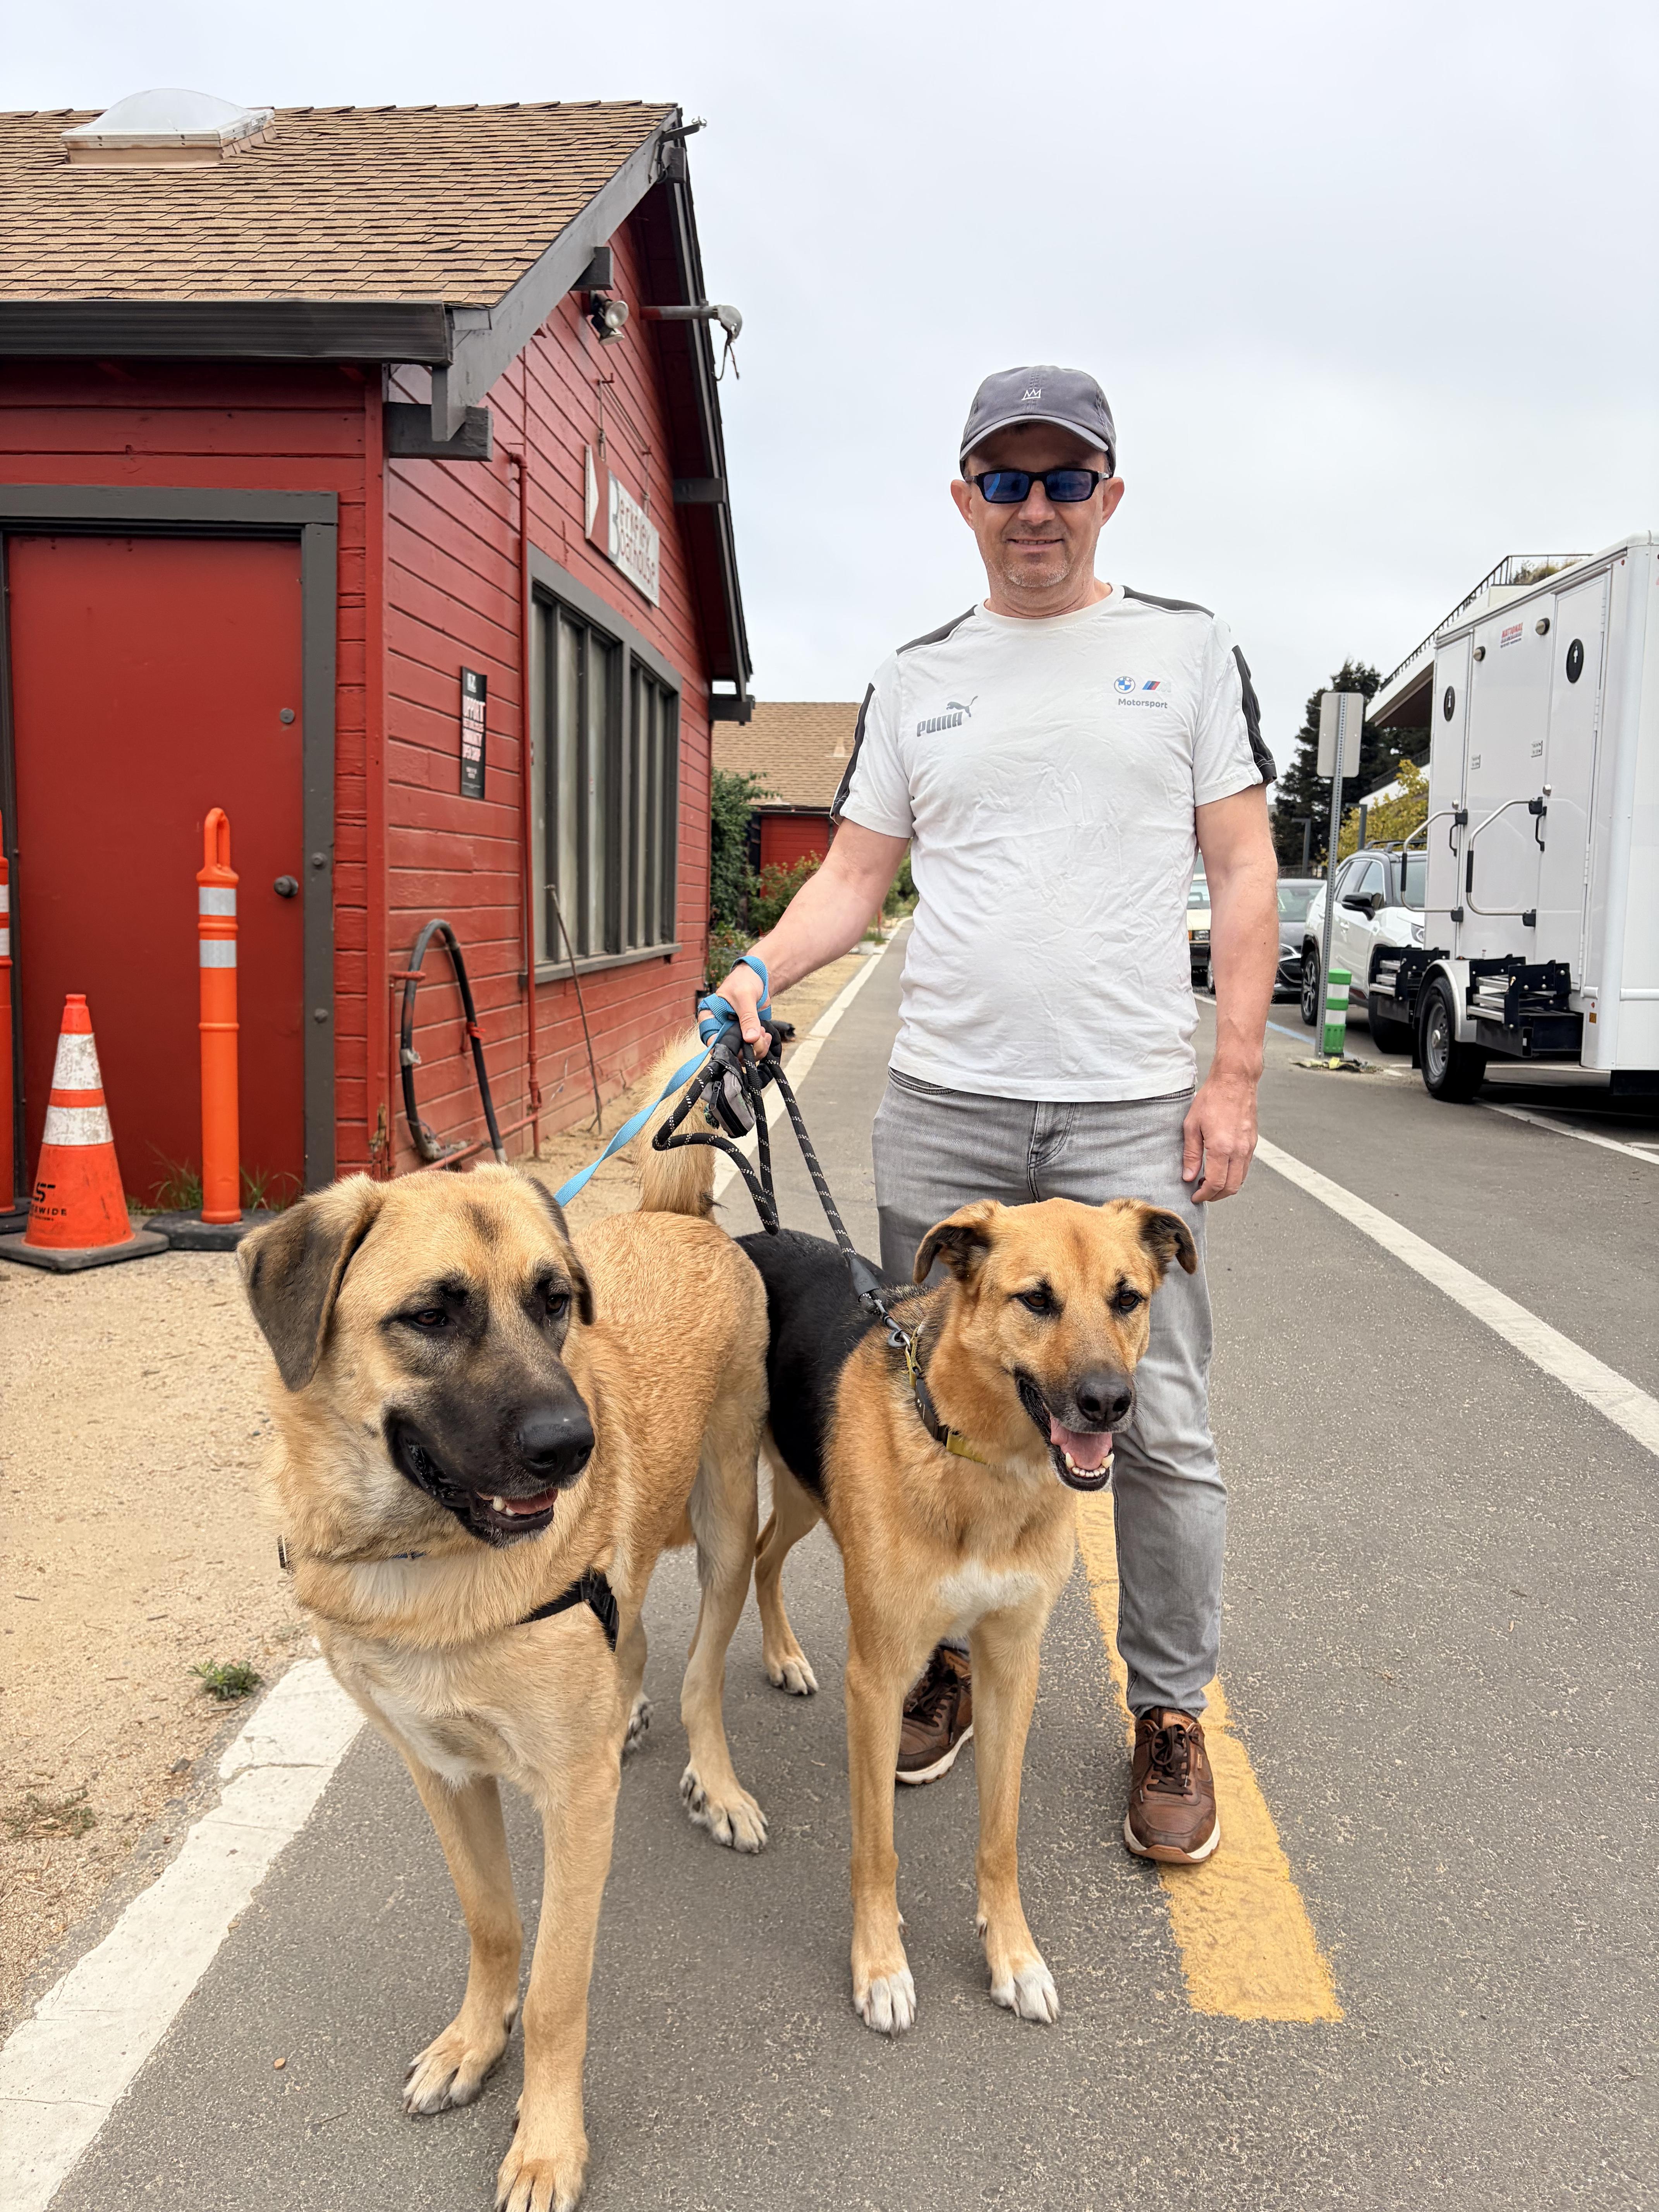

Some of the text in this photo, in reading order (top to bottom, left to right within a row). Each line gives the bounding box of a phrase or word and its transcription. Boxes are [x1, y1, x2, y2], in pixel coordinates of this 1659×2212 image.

[1502, 622, 1523, 638] NATIONAL
[1118, 698, 1168, 708] Motorsport
[917, 711, 963, 737] PUMA
